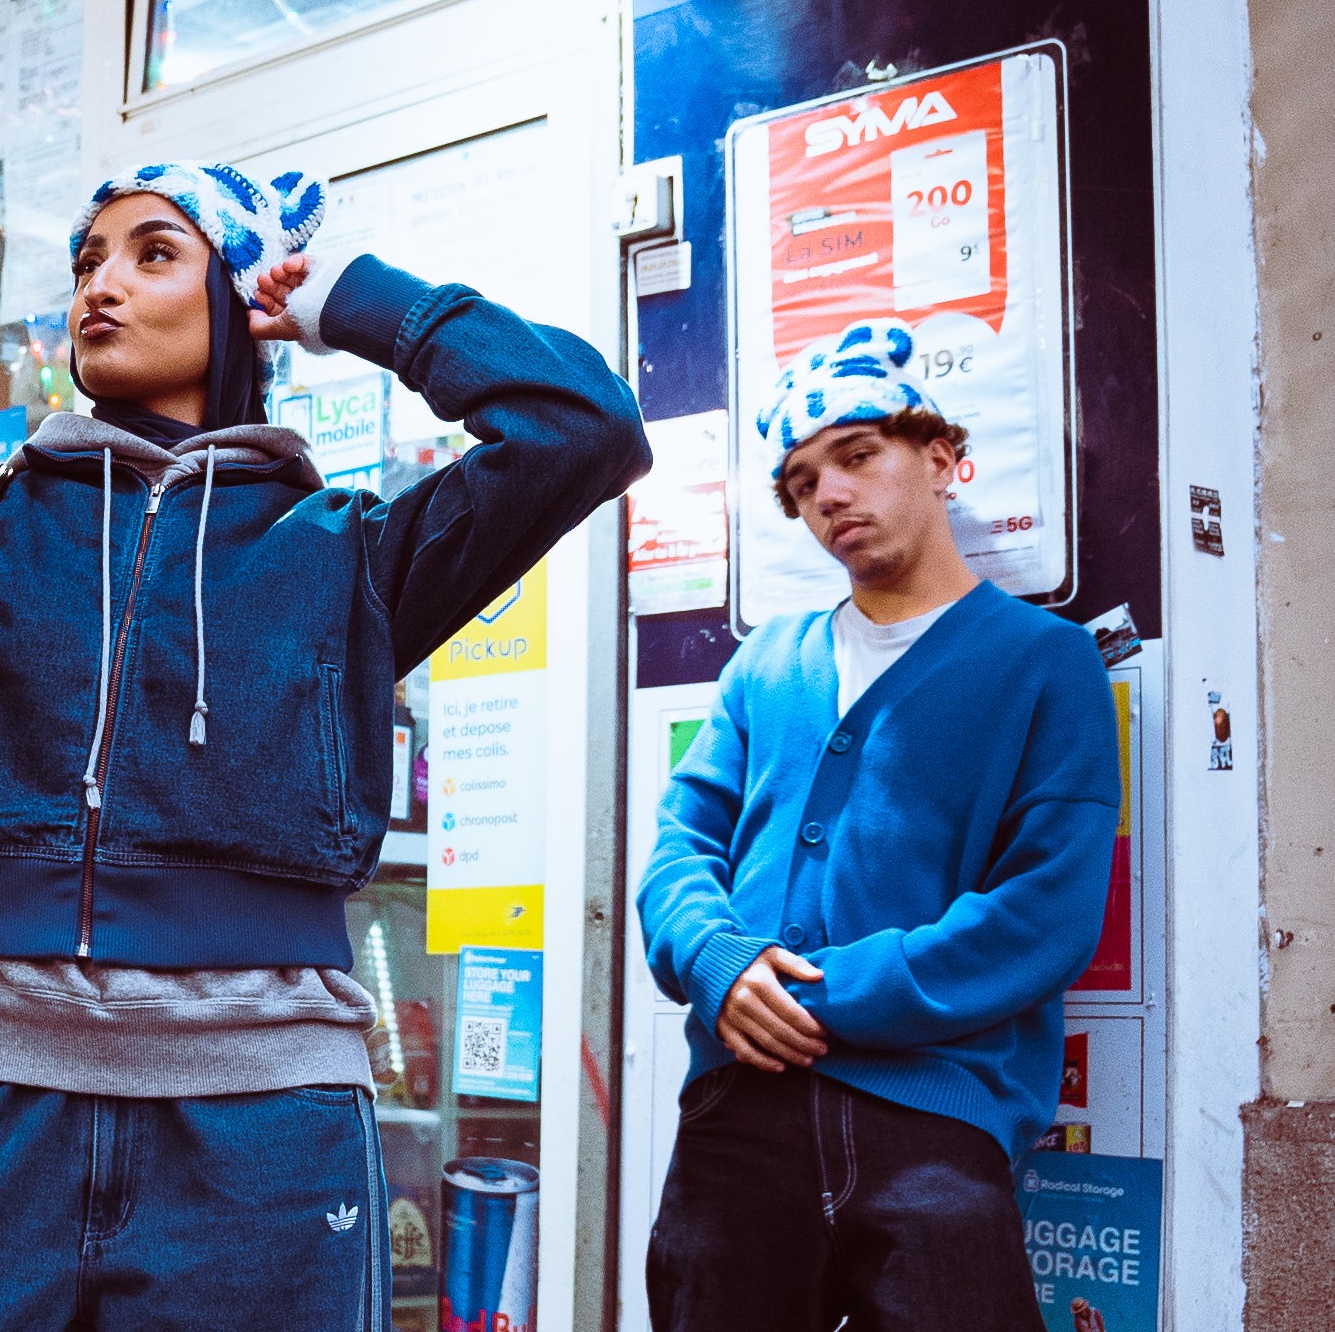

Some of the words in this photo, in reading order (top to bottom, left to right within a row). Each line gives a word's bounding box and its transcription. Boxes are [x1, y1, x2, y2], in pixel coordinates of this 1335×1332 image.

[805, 90, 957, 158] SYMA
[906, 179, 973, 218] 200
[822, 230, 864, 256] SIM
[316, 392, 376, 424] Lyca
[316, 419, 376, 444] mobile
[449, 634, 529, 665] Pickup
[443, 701, 461, 718] Ici,
[464, 699, 478, 718] je
[481, 696, 518, 713] retire
[442, 726, 457, 739] et
[442, 747, 472, 761] mes
[475, 741, 510, 759] colis.
[459, 778, 506, 792] colissimo
[459, 813, 519, 828] chronopost
[459, 850, 479, 864] dpd
[1082, 1182, 1125, 1199] Storage
